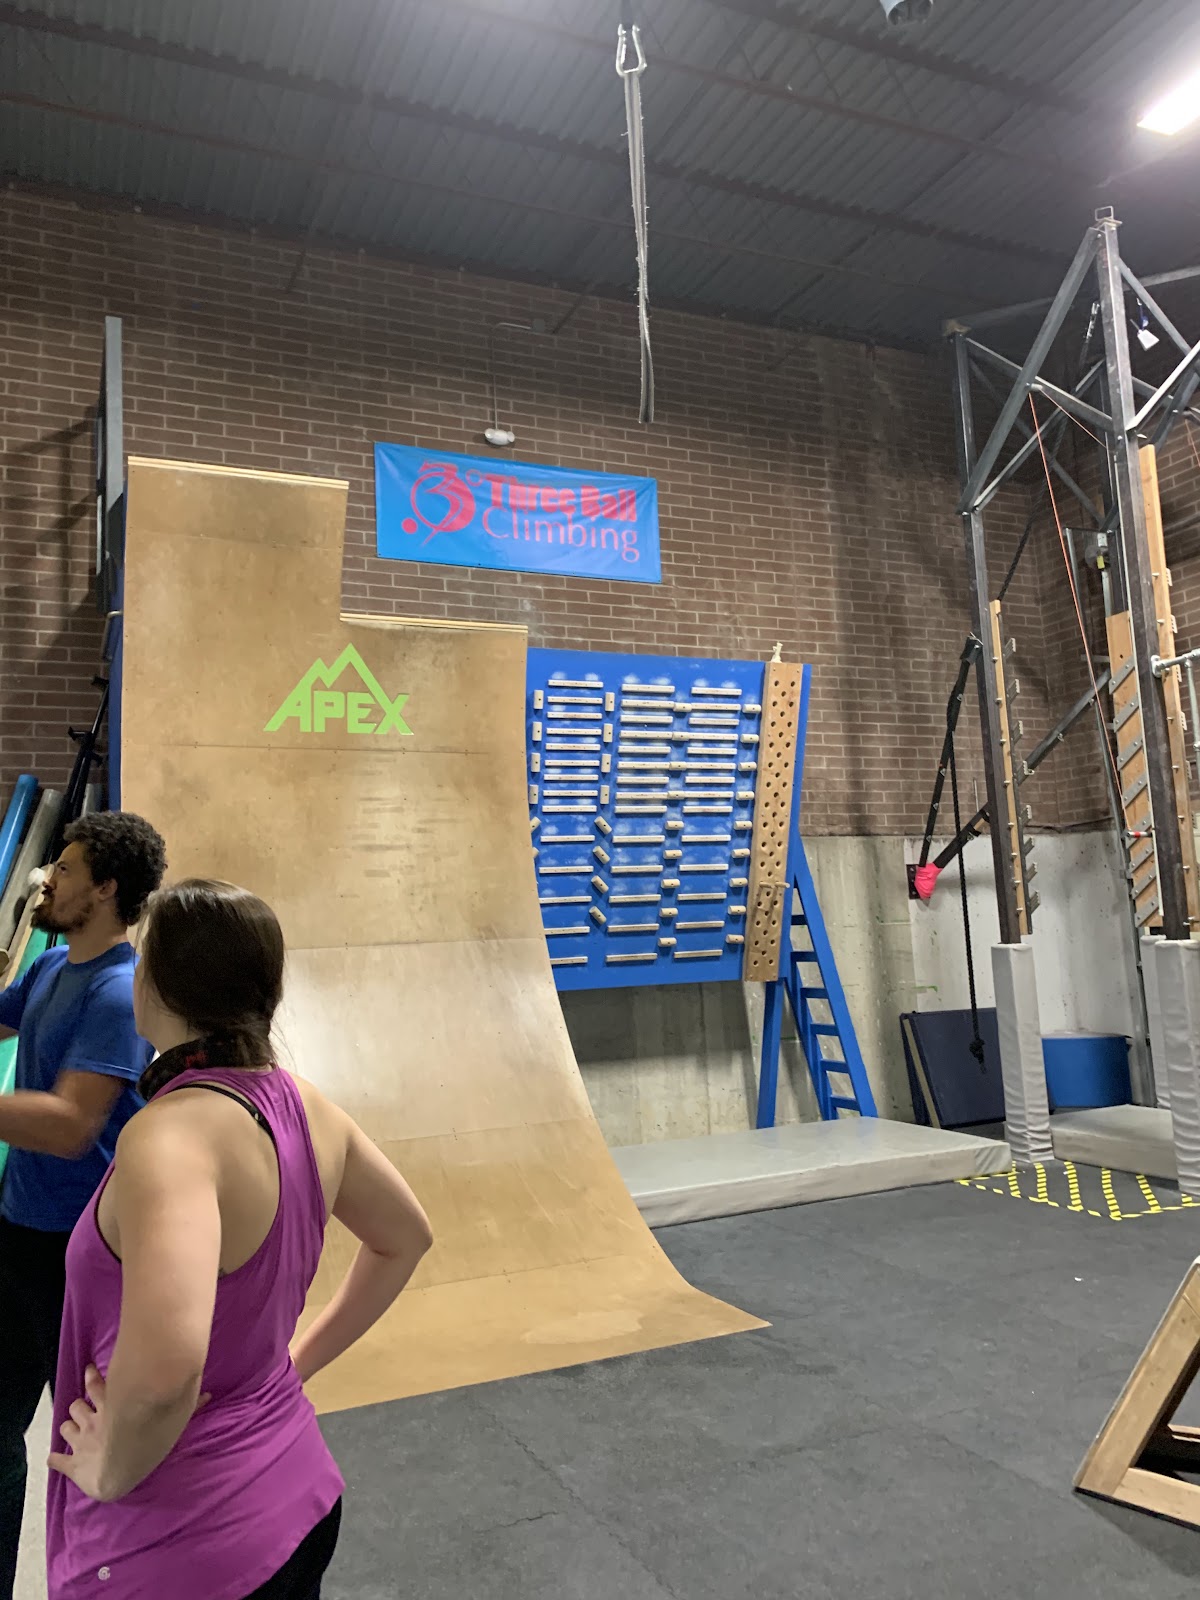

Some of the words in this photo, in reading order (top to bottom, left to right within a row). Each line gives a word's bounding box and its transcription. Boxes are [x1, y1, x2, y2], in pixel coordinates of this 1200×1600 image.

[484, 473, 577, 514] Three
[581, 485, 638, 523] Ball
[482, 506, 640, 563] Climbing
[263, 642, 414, 735] APEX
